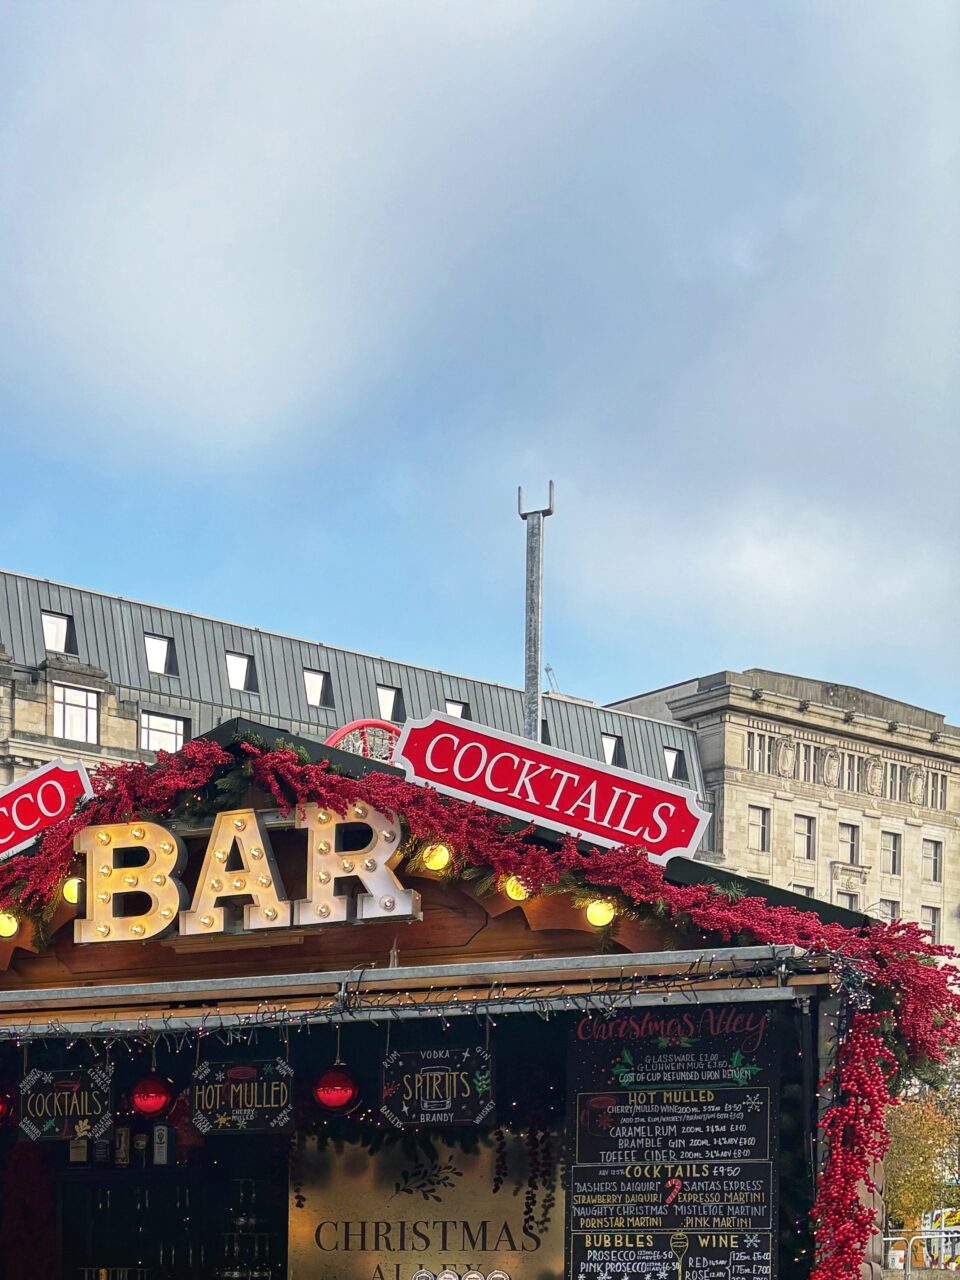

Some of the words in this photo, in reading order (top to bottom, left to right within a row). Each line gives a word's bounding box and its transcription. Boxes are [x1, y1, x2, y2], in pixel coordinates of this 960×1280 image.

[425, 732, 675, 845] COCKTAILS
[73, 802, 423, 945] BAR
[577, 1012, 695, 1041] Christmas
[698, 1007, 767, 1053] Alley
[382, 1050, 400, 1069] RUM
[420, 1049, 450, 1059] VODKA
[475, 1046, 491, 1061] GIN
[644, 1053, 695, 1063] GLASSWARE
[687, 1061, 705, 1070] MUG
[619, 1072, 636, 1083] COST
[636, 1073, 646, 1081] OF
[647, 1072, 661, 1082] CUP
[663, 1071, 700, 1081] REFUNDED
[701, 1070, 720, 1081] UPON
[722, 1069, 751, 1080] RETURN
[402, 1071, 471, 1100] SPIRITS
[195, 1084, 223, 1110] HOT
[230, 1081, 288, 1108] MULLED
[628, 1091, 656, 1105] HOT
[664, 1090, 715, 1104] MULLED
[27, 1090, 102, 1117] COCKTAILS
[607, 1104, 659, 1116] CHERRY/MULLED
[660, 1104, 678, 1114] WINE
[420, 1112, 454, 1123] BRANDY
[609, 1126, 653, 1138] CARAMEL
[655, 1125, 677, 1137] RUM
[618, 1137, 662, 1149] BRAMBLE
[668, 1139, 686, 1148] GIN
[599, 1150, 637, 1162] TOFFEE
[644, 1149, 678, 1161] CIDER
[624, 1164, 710, 1178] COCKTAILS
[573, 1193, 623, 1205] STRAWBERRY
[625, 1193, 662, 1204] DAIQUIRI
[678, 1192, 721, 1203] EXPRESSO
[724, 1191, 765, 1203] MARTINI
[580, 1216, 625, 1228] PORNSTAR
[627, 1216, 662, 1228] MARTINI
[686, 1216, 710, 1227] PINK
[712, 1216, 752, 1228] MARTINI
[314, 1220, 541, 1252] CHRISTMAS
[585, 1234, 654, 1248] BUBBLES
[698, 1235, 739, 1248] WINE
[587, 1249, 636, 1261] PROSECCO
[580, 1262, 604, 1273] PINK
[605, 1262, 647, 1273] PROSECCO
[688, 1257, 709, 1268] RED
[685, 1267, 710, 1280] ROSÉ
